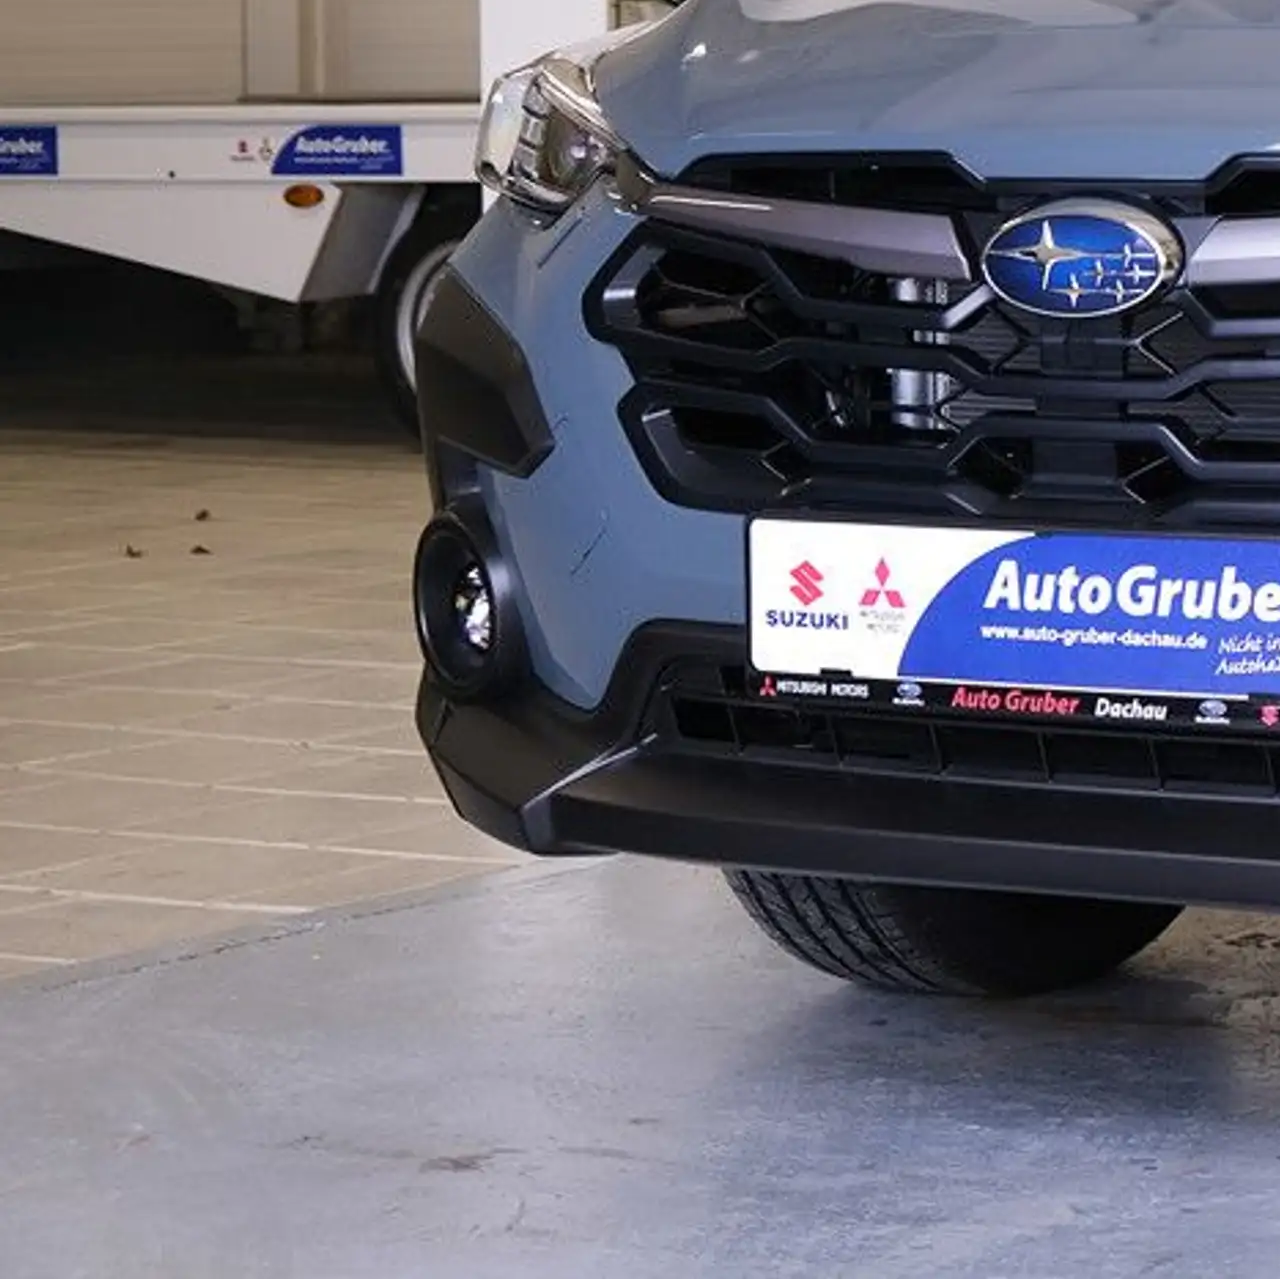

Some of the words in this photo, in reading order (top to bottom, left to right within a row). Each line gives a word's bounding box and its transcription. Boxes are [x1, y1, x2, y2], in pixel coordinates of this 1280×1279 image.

[765, 609, 849, 630] SUZUKI
[980, 624, 1206, 650] www.auto-gruber-dachau.de
[1217, 633, 1262, 654] Nicht
[952, 686, 999, 710] Auto
[1004, 690, 1080, 715] Gruber
[1094, 697, 1168, 721] Dachau
